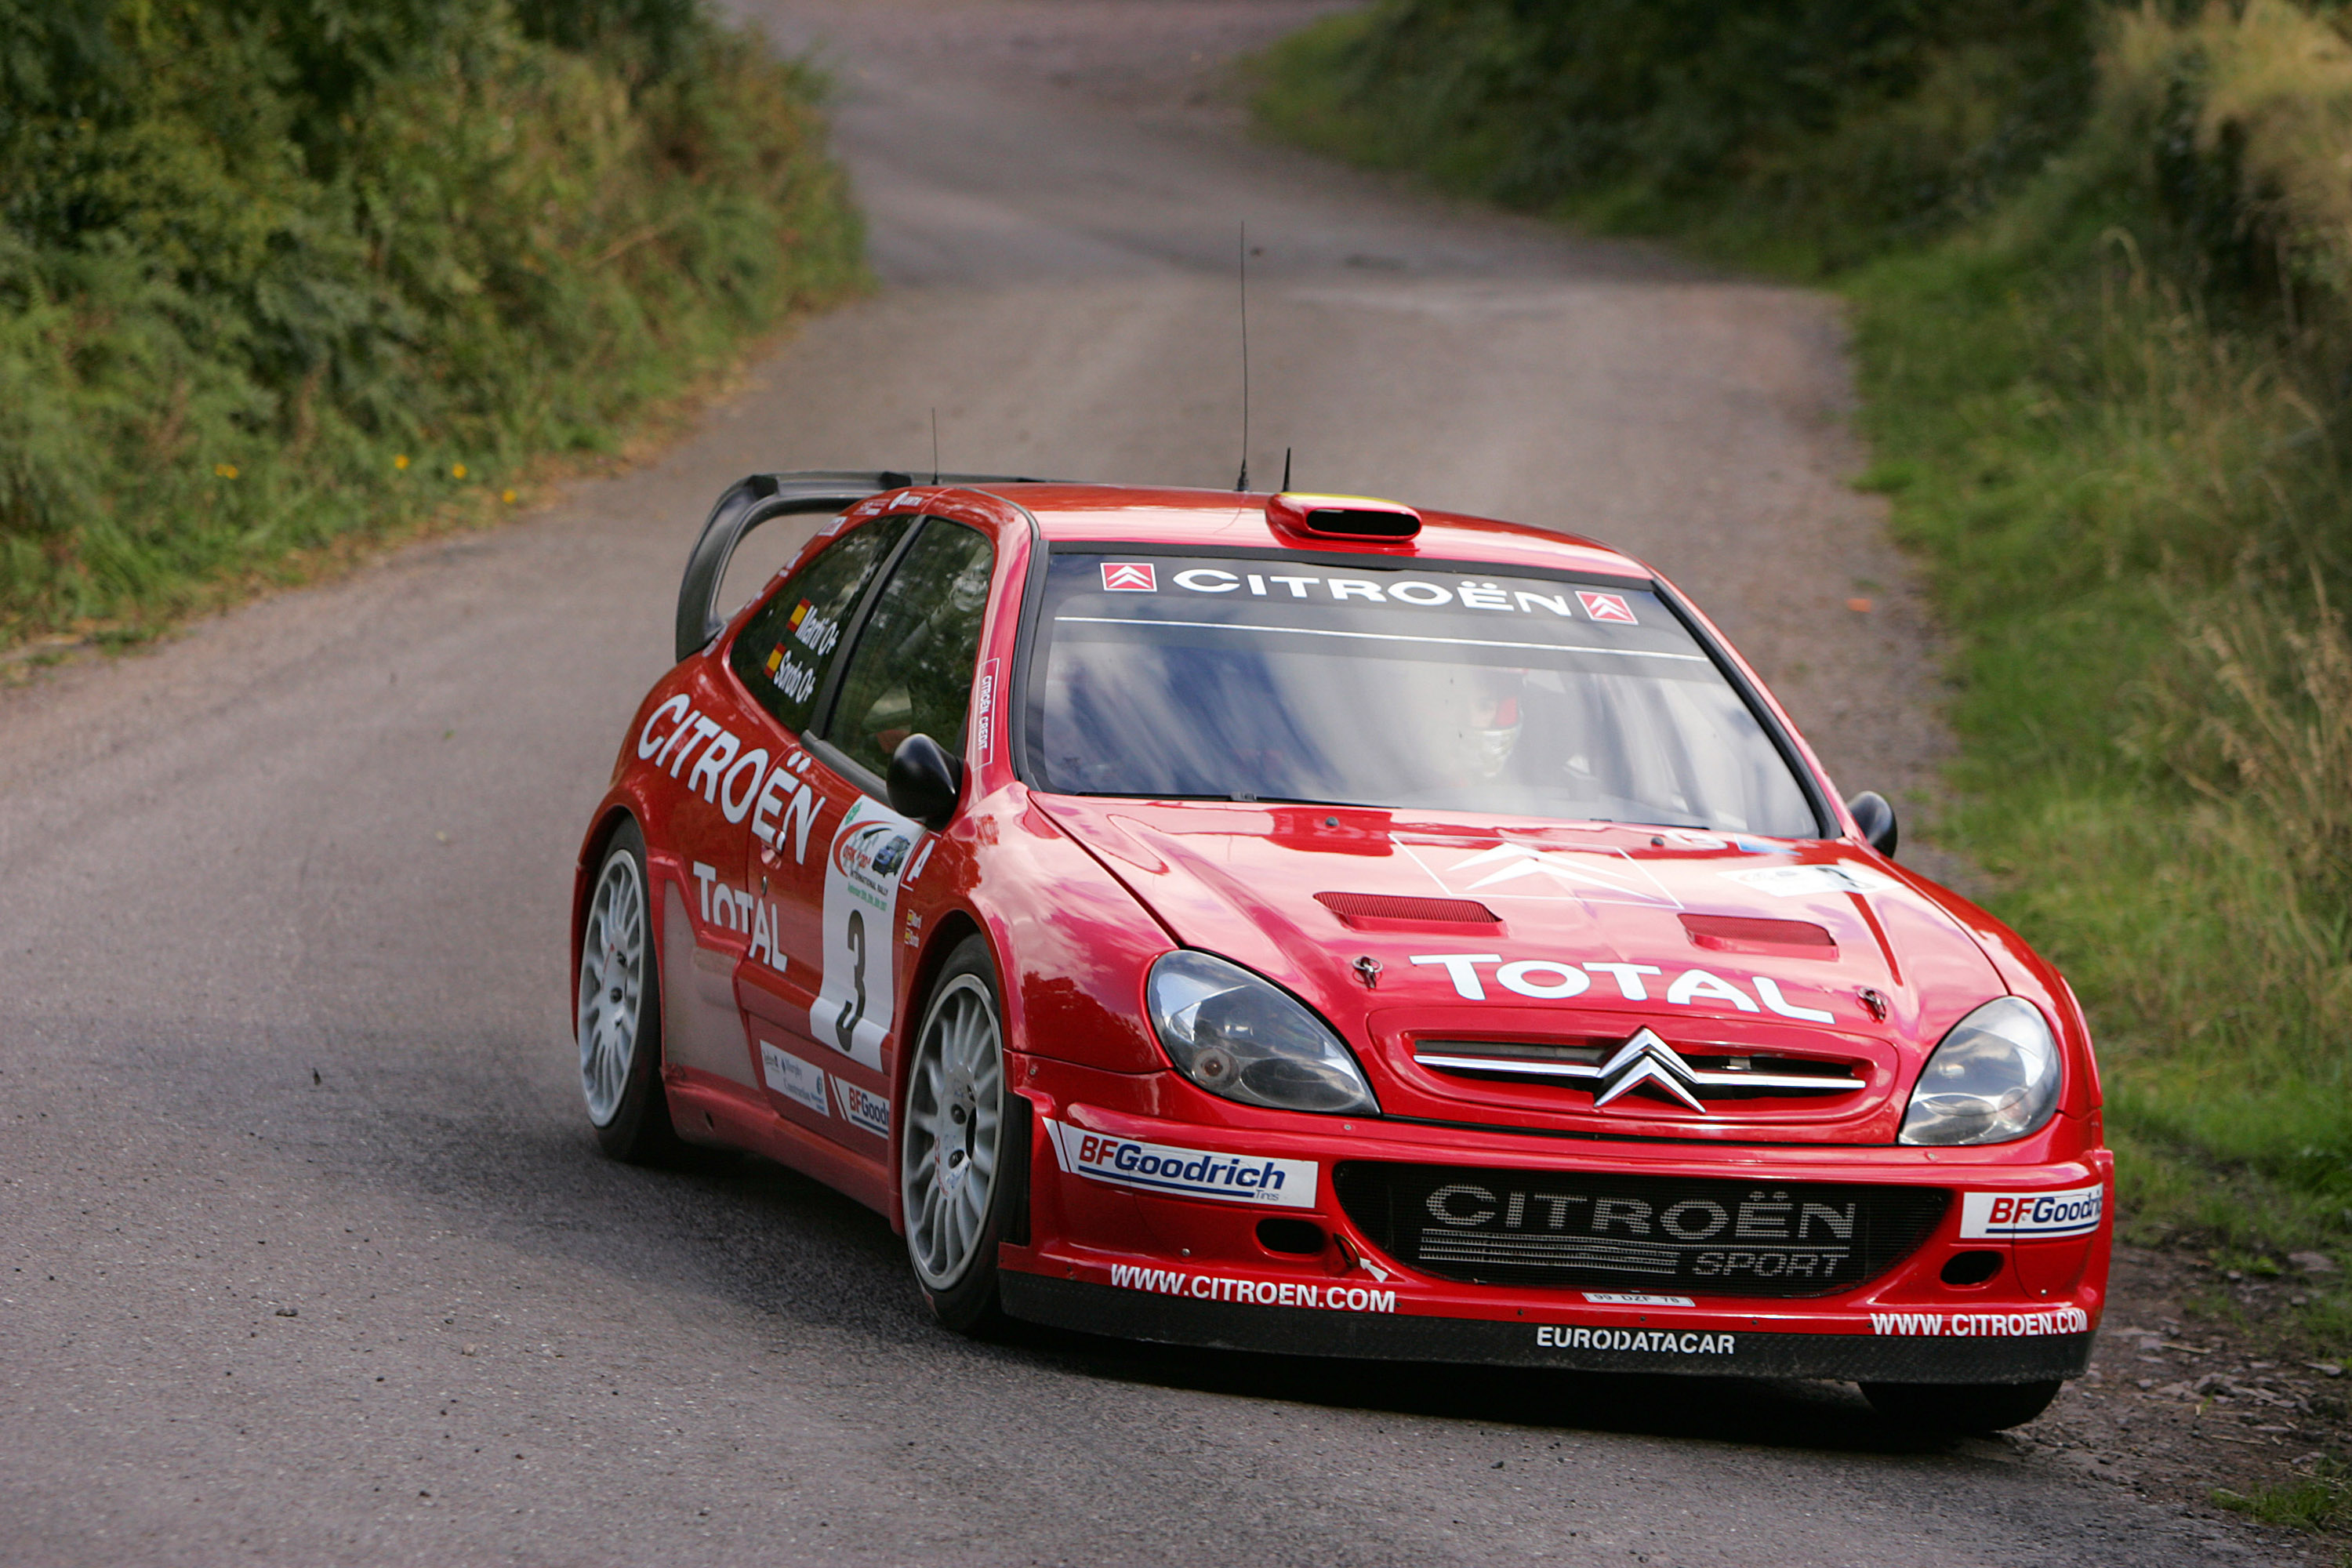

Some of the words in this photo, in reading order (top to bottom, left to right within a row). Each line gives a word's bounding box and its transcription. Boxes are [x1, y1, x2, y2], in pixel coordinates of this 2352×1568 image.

[1172, 568, 1573, 617] CITROËN
[773, 650, 803, 699] Sordo
[637, 693, 826, 866] CITROËN
[693, 860, 788, 973] TOTAL
[836, 909, 866, 1052] 3
[1409, 953, 1835, 1024] TOTAL
[1079, 1134, 1286, 1189] BFGoodrich
[1254, 1189, 1279, 1202] Tires
[1426, 1184, 1856, 1240] CITROËN
[1110, 1263, 1396, 1313] WWW.CITROEN.COM
[1692, 1252, 1850, 1277] SPORT
[1536, 1326, 1736, 1355] EURODATACAR
[1870, 1308, 2088, 1337] WWW.CITROEN.COM
